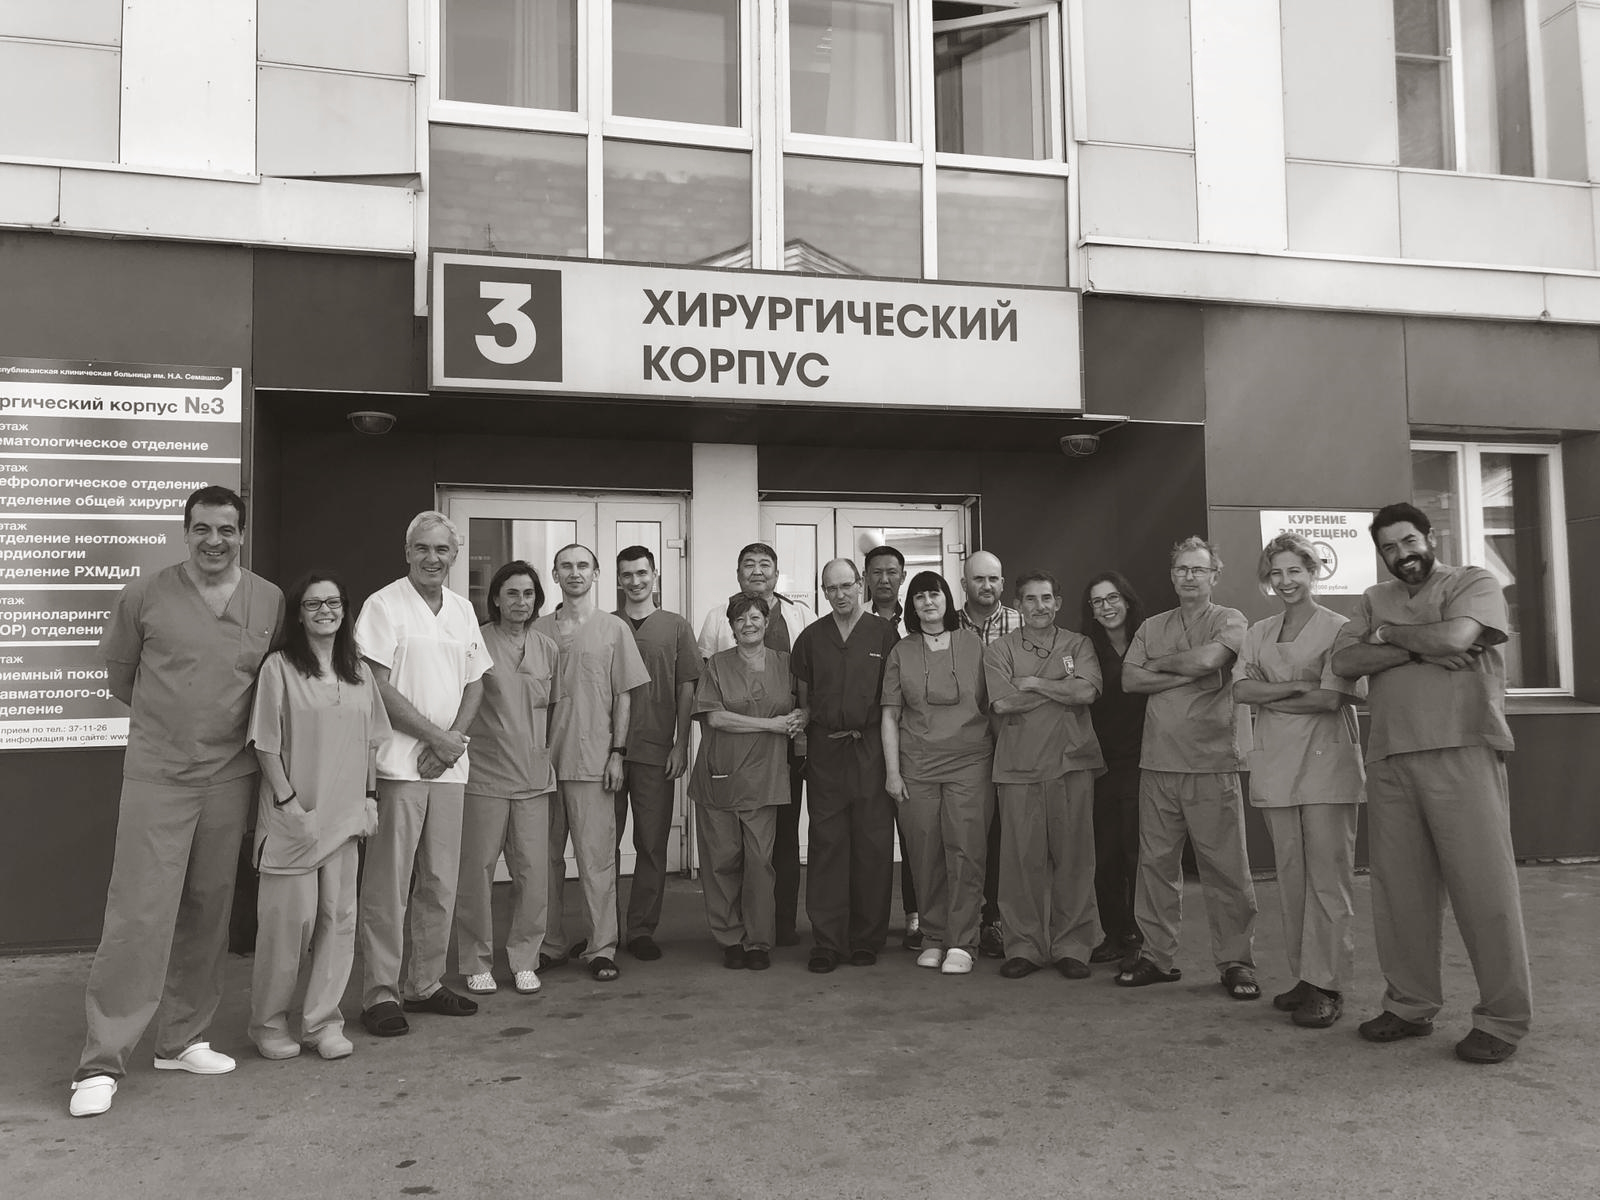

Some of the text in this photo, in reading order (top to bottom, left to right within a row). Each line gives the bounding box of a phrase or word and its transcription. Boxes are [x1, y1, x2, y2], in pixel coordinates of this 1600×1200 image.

[642, 288, 1018, 342] ХИРУРГИЧЕСКИЙ
[474, 281, 538, 364] 3
[643, 344, 831, 388] КОРПУС
[60, 369, 112, 377] клиническая
[113, 371, 151, 380] больница
[0, 396, 225, 416] ргический корпус №3
[0, 423, 29, 432] этаж
[0, 437, 209, 451] матологическое отделение
[0, 464, 29, 473] этаж
[0, 475, 209, 491] ефрологическое отделение
[0, 496, 71, 507] тделение
[75, 494, 125, 509] общей
[1288, 514, 1347, 525] КУРЕНИЕ
[0, 533, 167, 546] тделение неотложной
[74, 565, 141, 580] РХМДиЛ
[0, 597, 25, 605] таж
[0, 668, 63, 681] иемный
[32, 726, 44, 734] по
[68, 724, 108, 733] 37-11-26
[5, 735, 65, 745] информация
